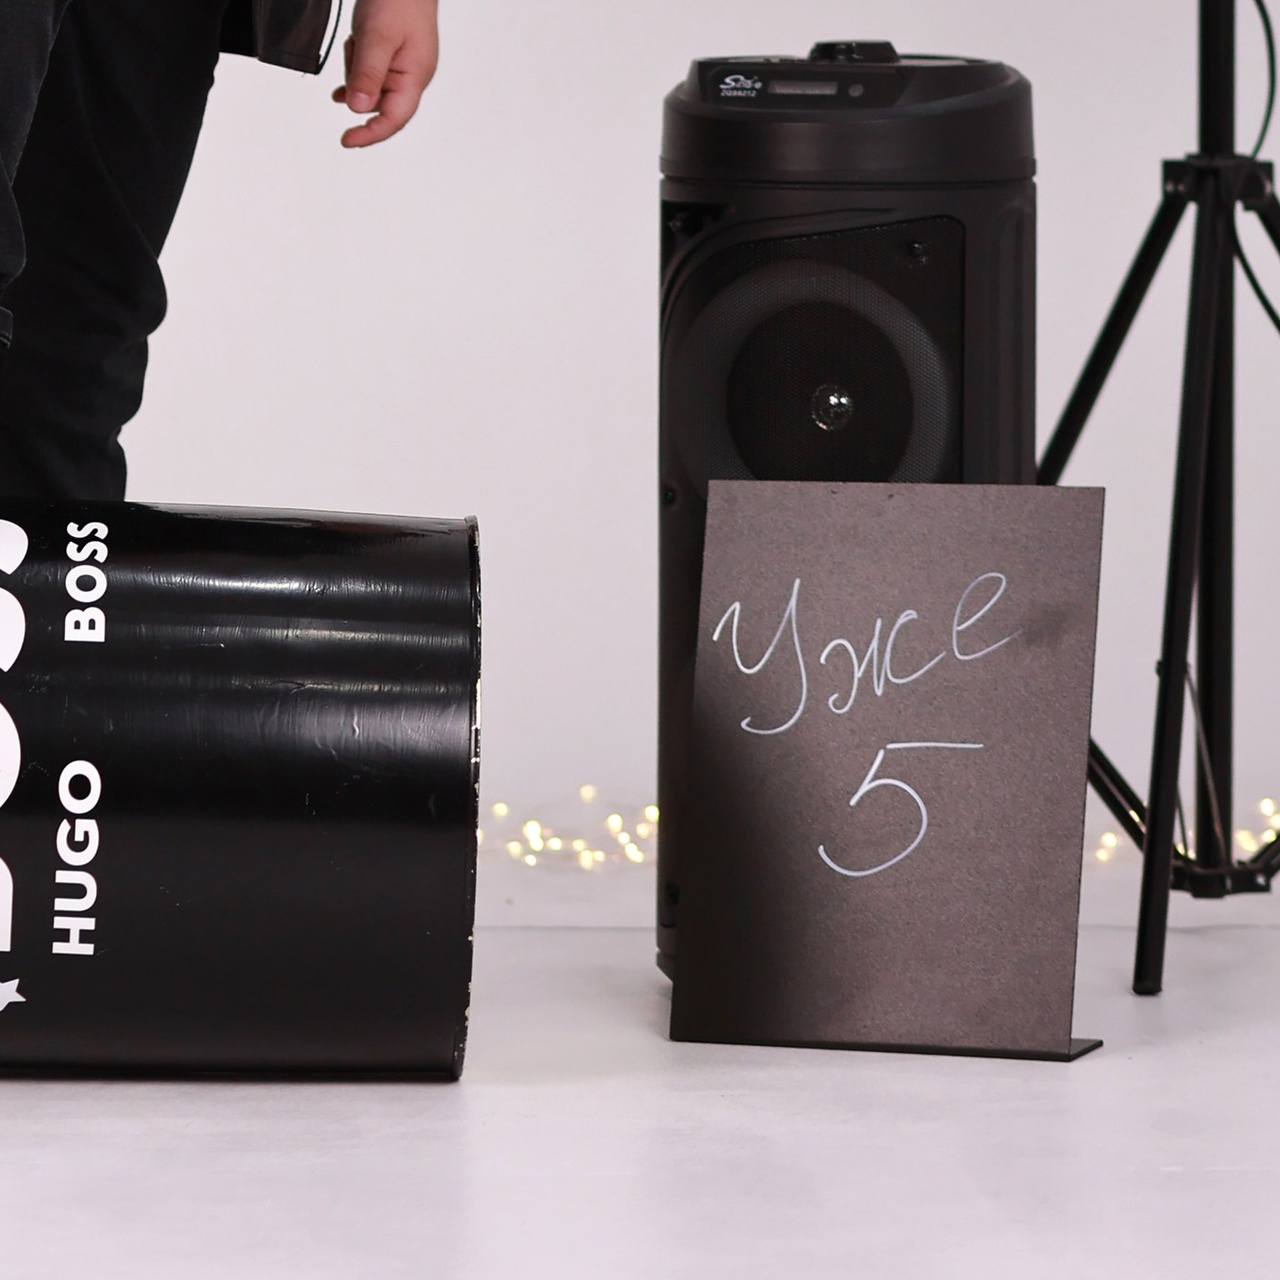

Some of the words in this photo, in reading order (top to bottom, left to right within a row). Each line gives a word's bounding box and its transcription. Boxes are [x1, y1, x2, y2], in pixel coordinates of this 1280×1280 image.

[65, 521, 109, 643] BOSS
[52, 760, 102, 956] HUGO
[818, 741, 984, 877] 5
